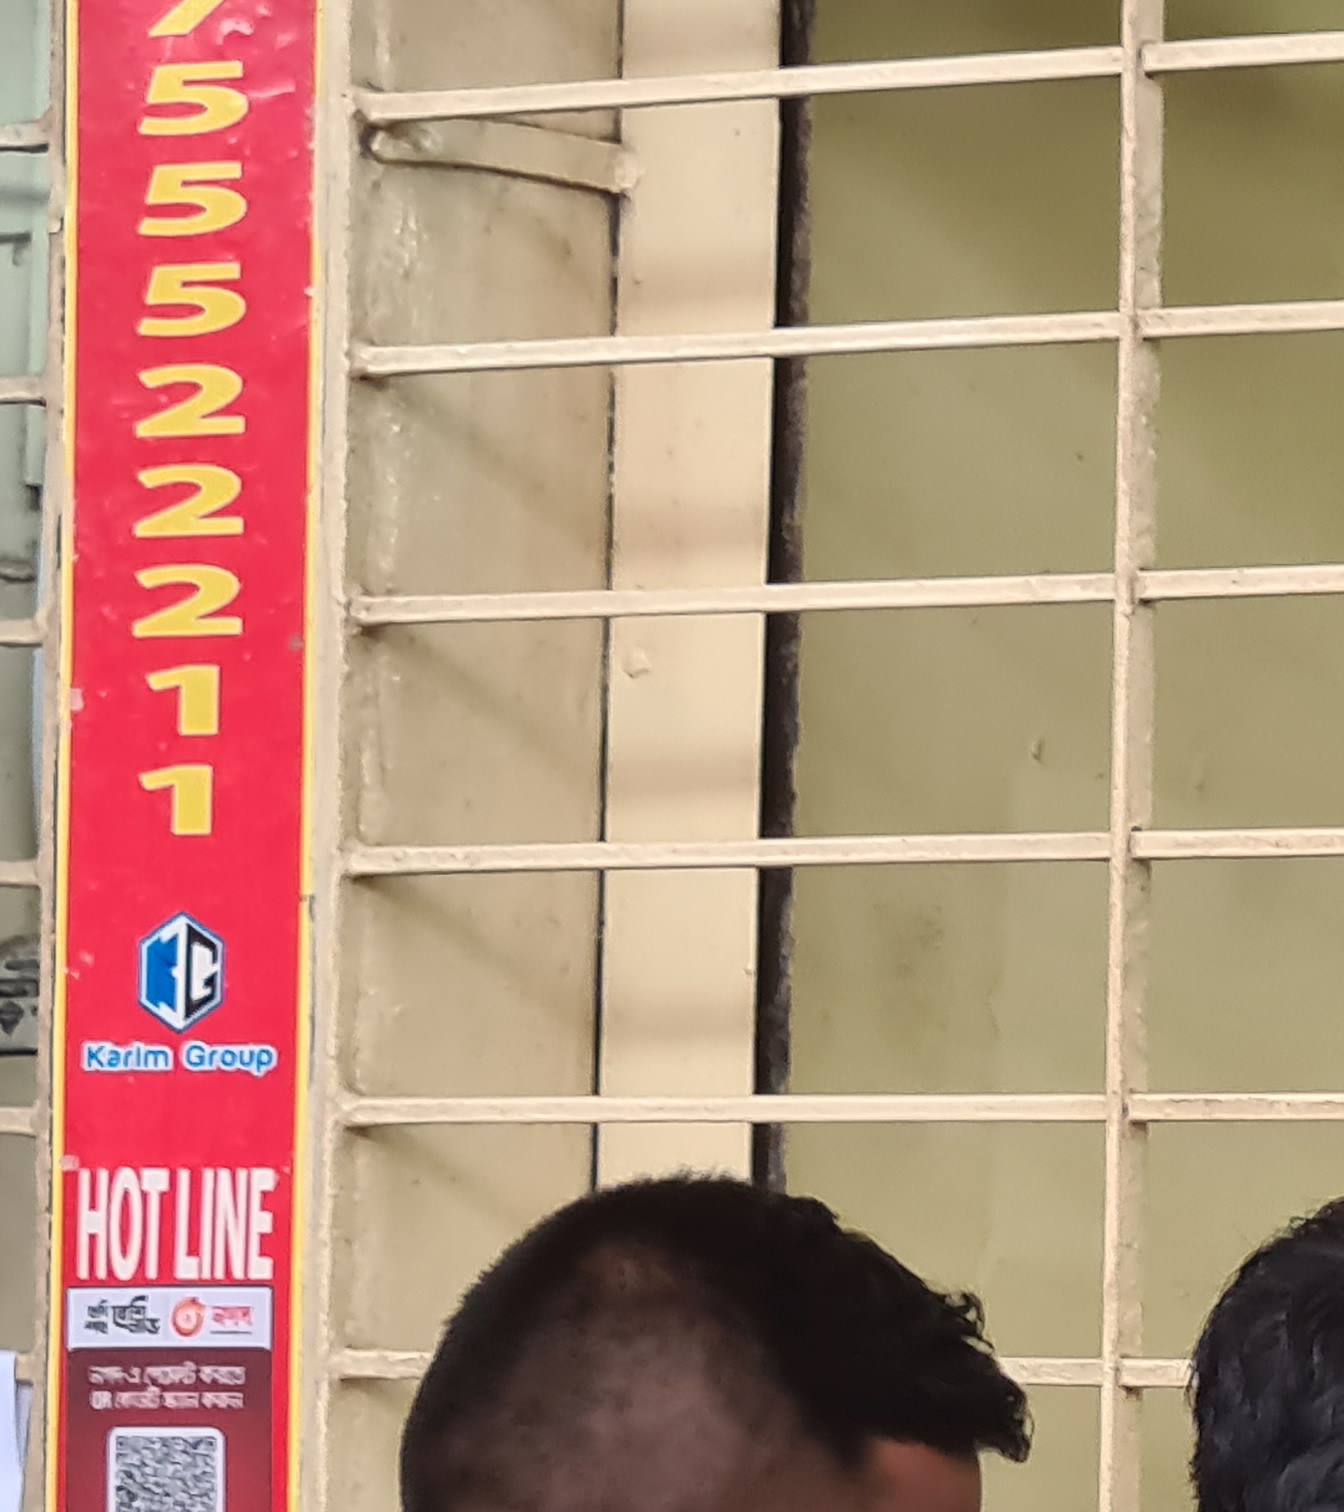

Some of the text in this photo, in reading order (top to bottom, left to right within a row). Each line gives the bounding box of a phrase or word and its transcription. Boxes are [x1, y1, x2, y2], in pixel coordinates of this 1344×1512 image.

[182, 1041, 277, 1077] Group
[77, 1166, 278, 1281] HOT LINE
